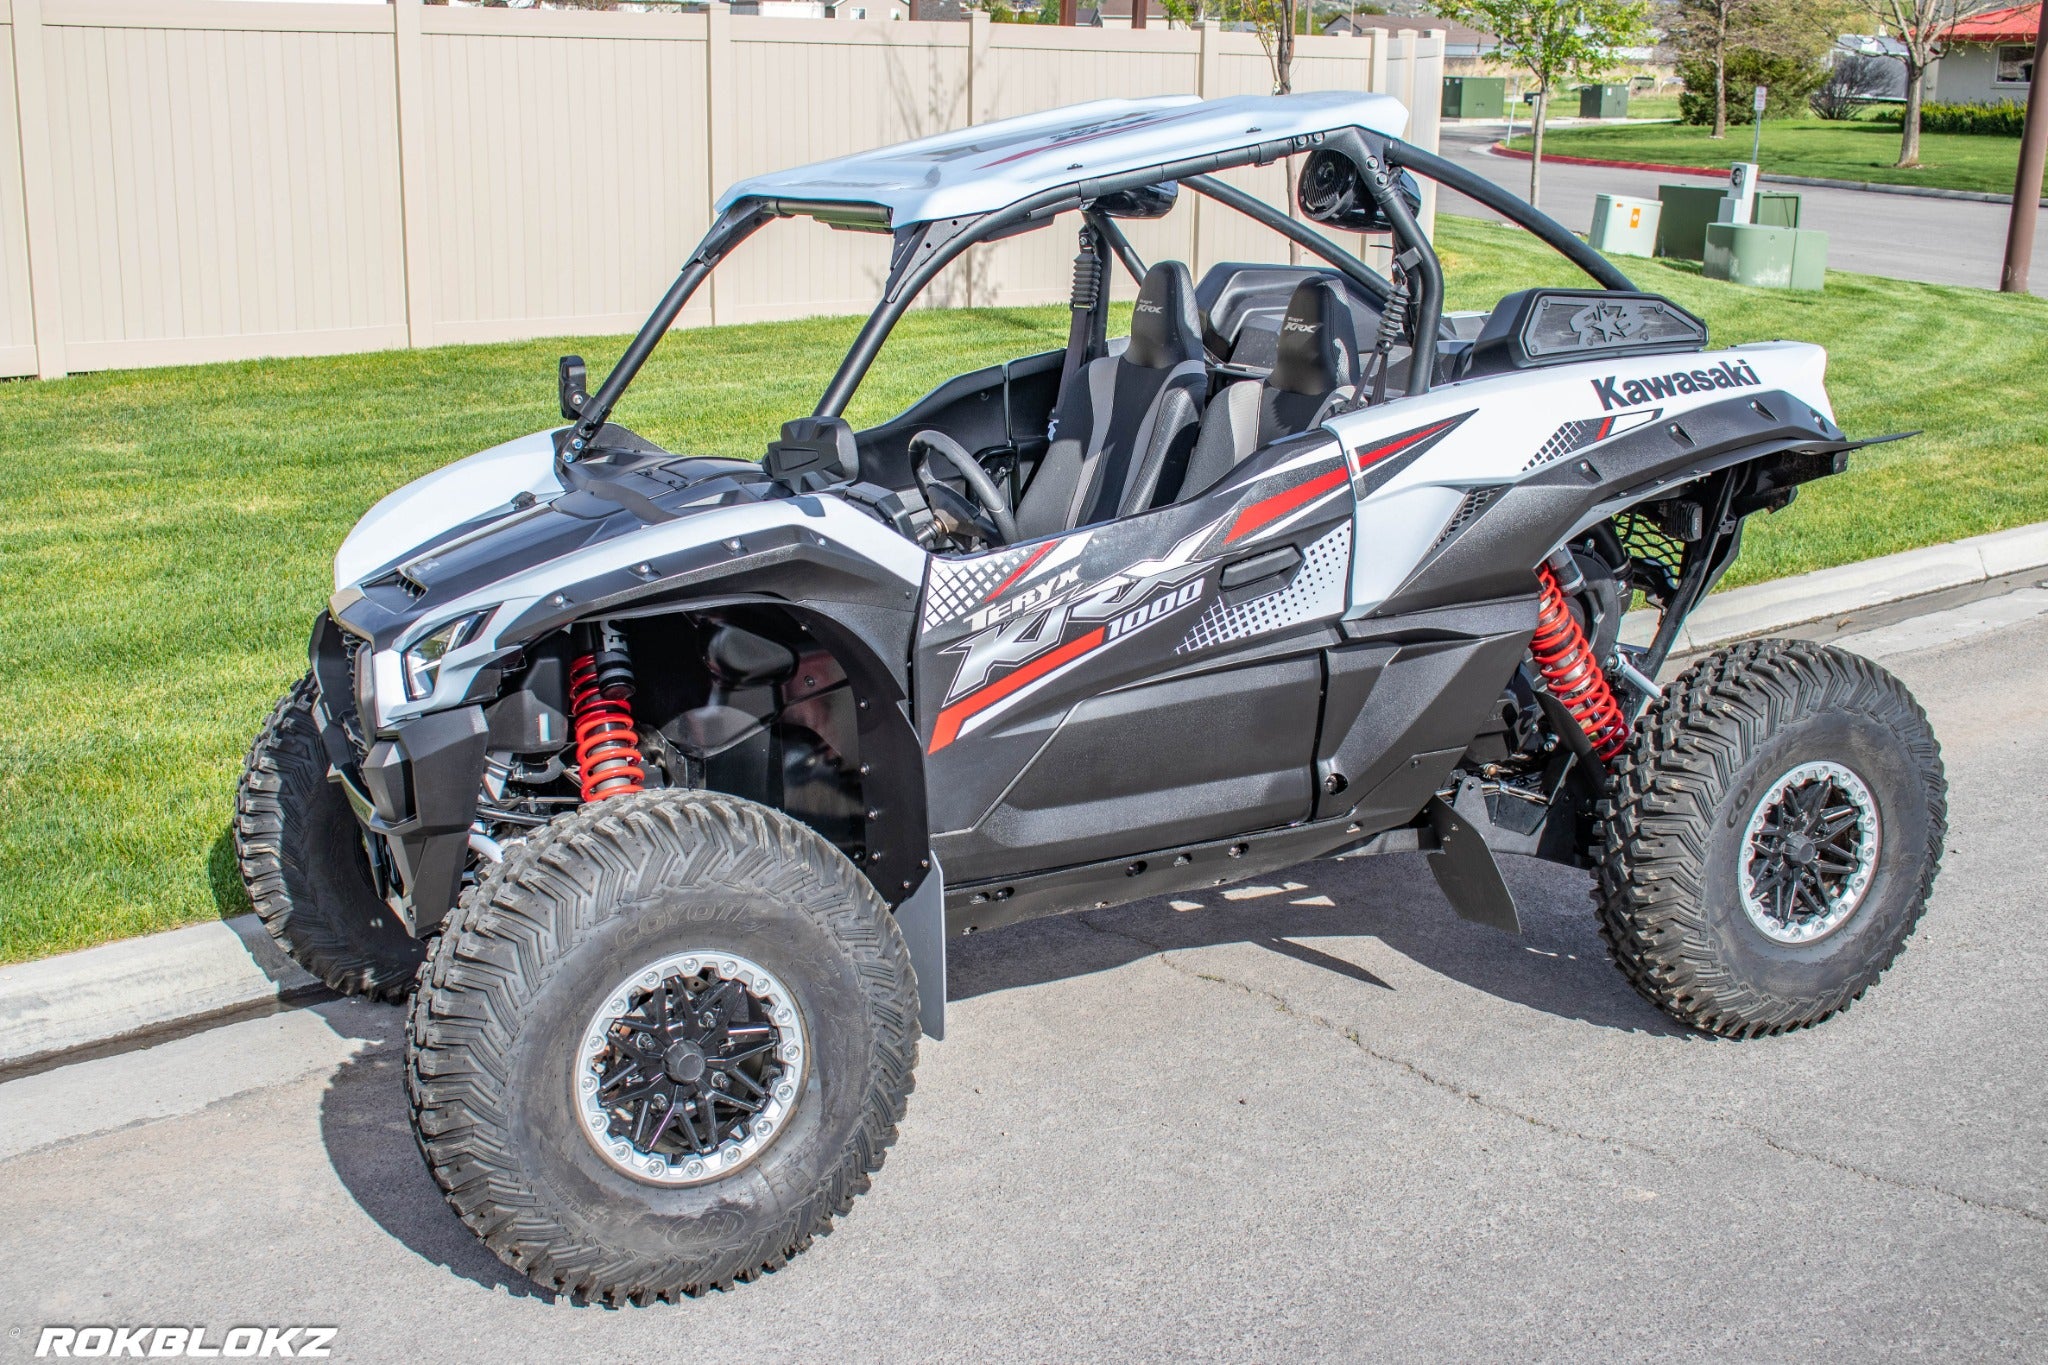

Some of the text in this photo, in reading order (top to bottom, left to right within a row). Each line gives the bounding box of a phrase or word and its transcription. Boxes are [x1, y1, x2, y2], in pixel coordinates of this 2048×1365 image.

[1591, 359, 1761, 411] Kawasaki
[940, 510, 1235, 707] KRX
[1108, 577, 1205, 641] 1000
